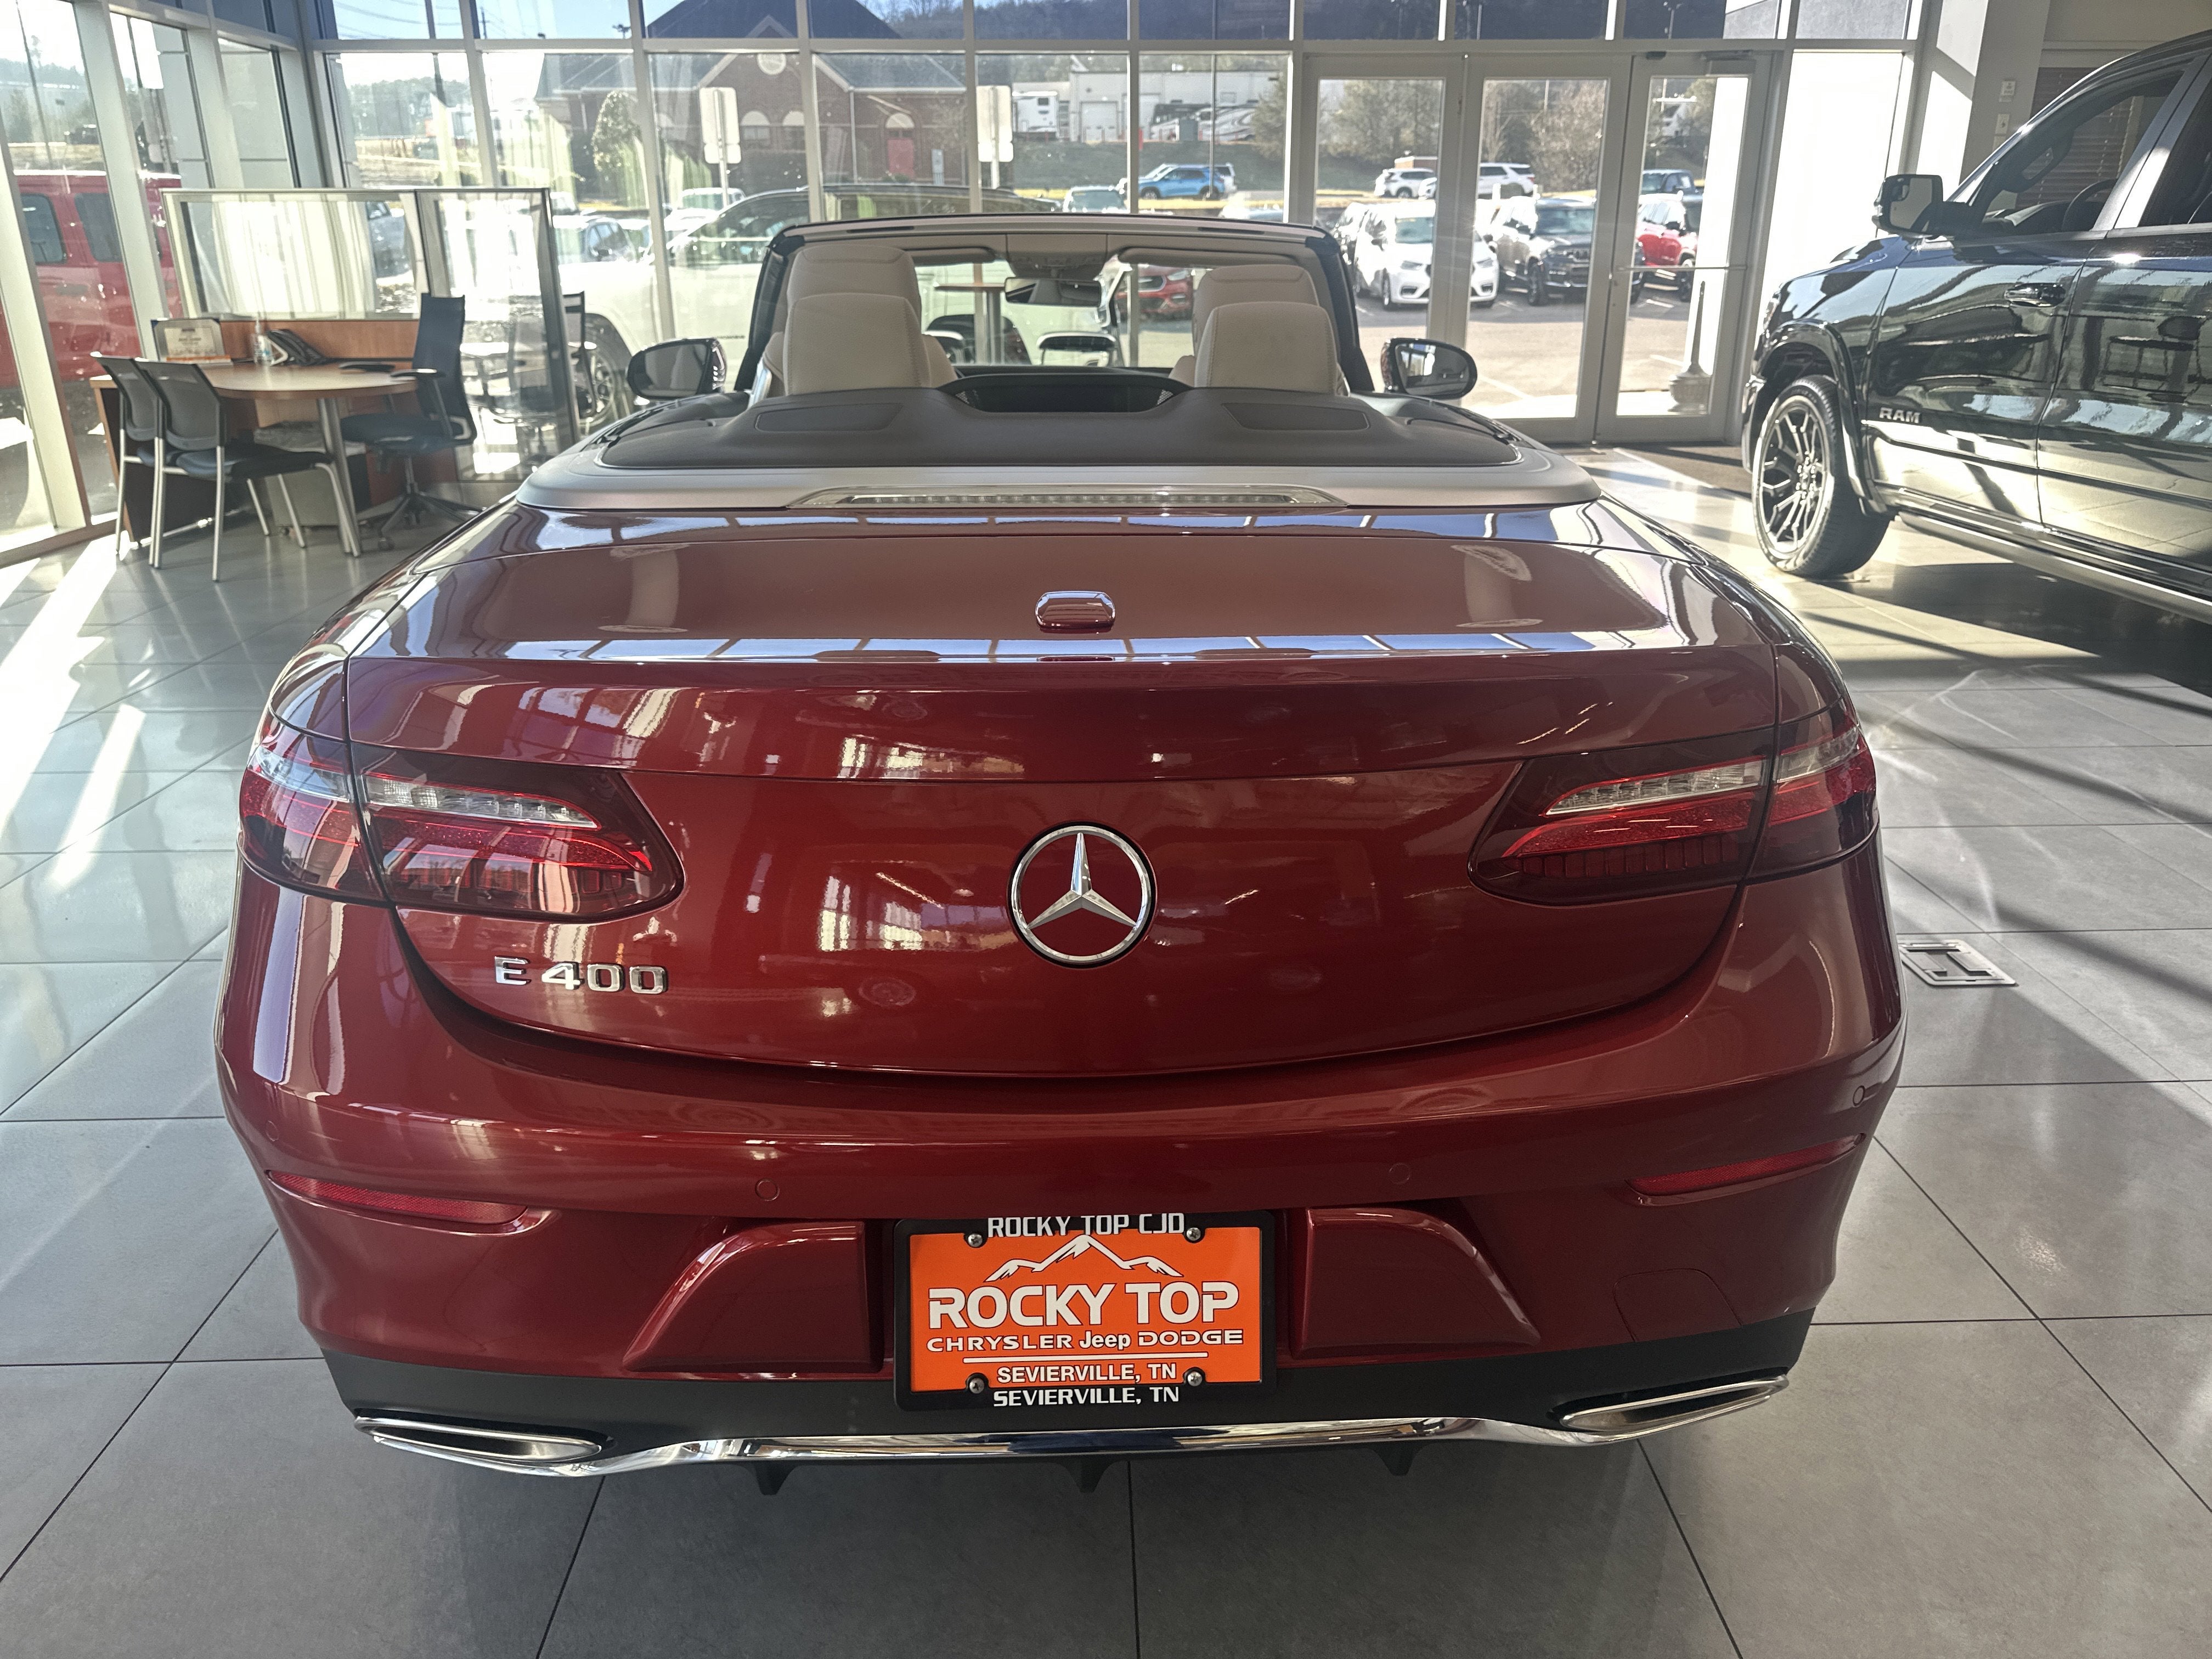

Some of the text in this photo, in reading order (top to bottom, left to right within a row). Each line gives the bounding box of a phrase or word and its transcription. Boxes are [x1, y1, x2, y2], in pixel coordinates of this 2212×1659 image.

[1879, 407, 1921, 424] RAM
[495, 956, 668, 994] E 400
[988, 1212, 1184, 1238] ROCKY TOP CJD
[928, 1281, 1239, 1329] ROCKY TOP
[927, 1329, 1244, 1352] CHRYSLER Jeep DODGE
[997, 1363, 1176, 1384] SEVIERVILLE, TN
[994, 1386, 1179, 1407] SEVIERVILLE, TN
